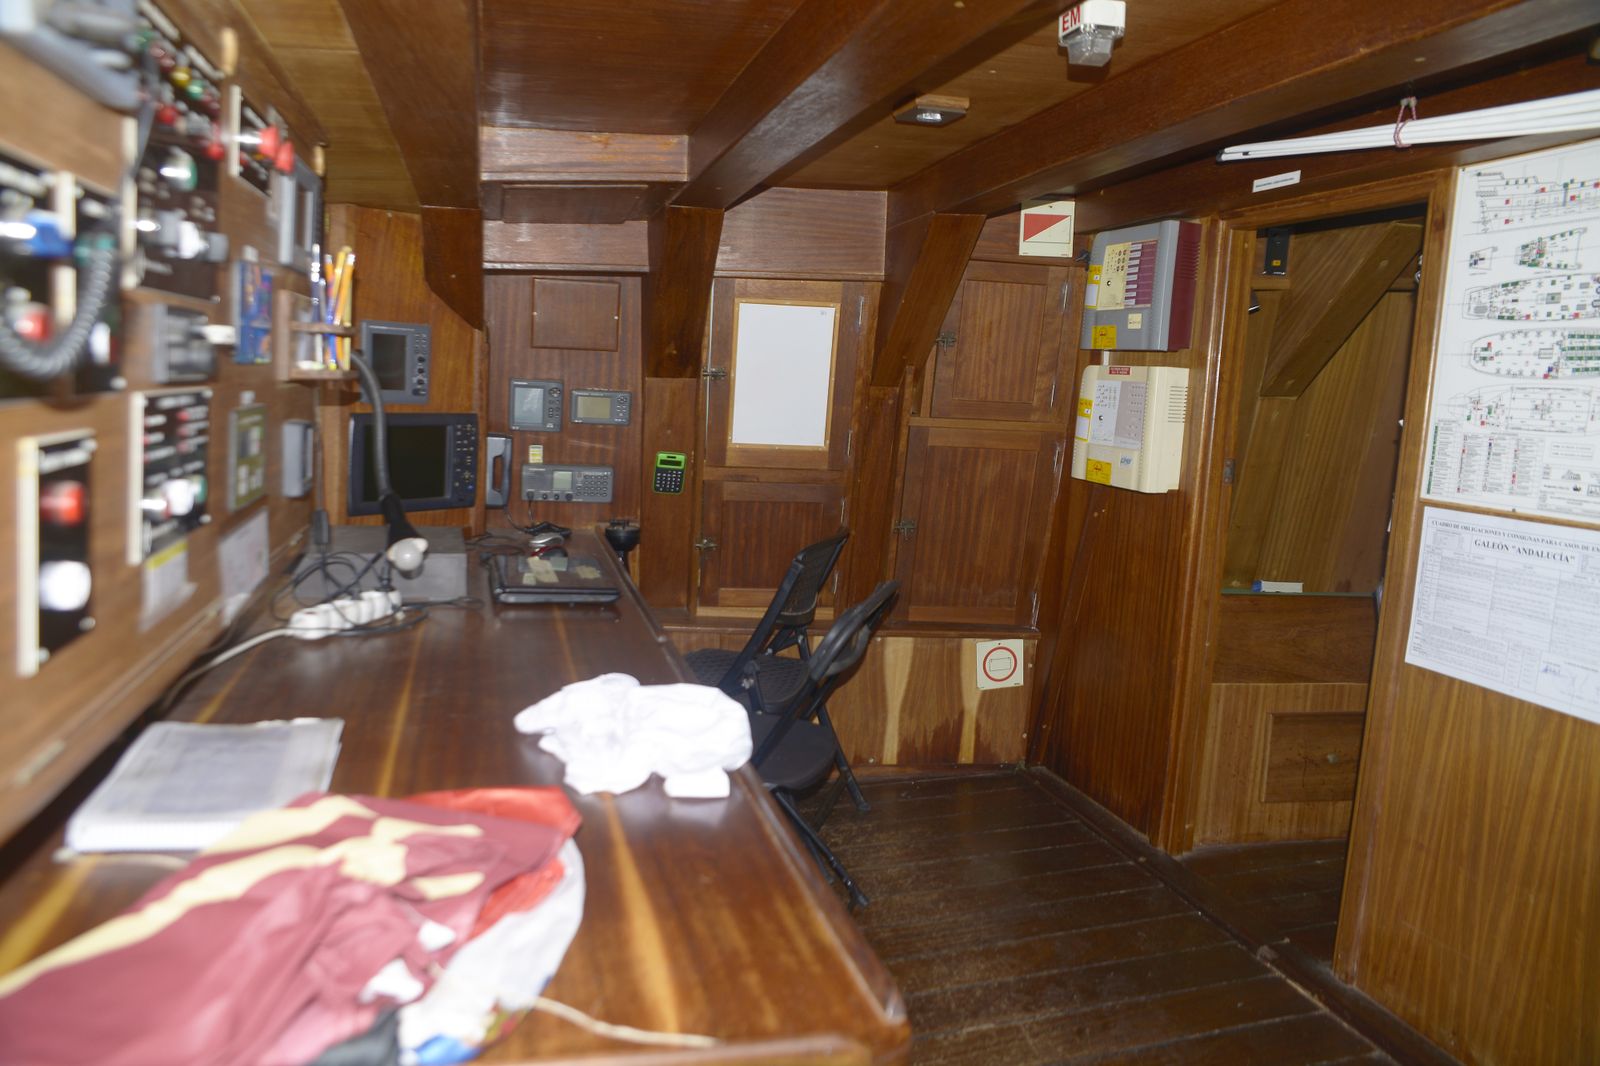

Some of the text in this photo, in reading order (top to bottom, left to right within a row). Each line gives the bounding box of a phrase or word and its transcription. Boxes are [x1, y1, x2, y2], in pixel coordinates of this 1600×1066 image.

[1062, 5, 1081, 32] EM
[1432, 520, 1453, 529] CUADRO
[1460, 524, 1501, 536] OBLIGACIONES
